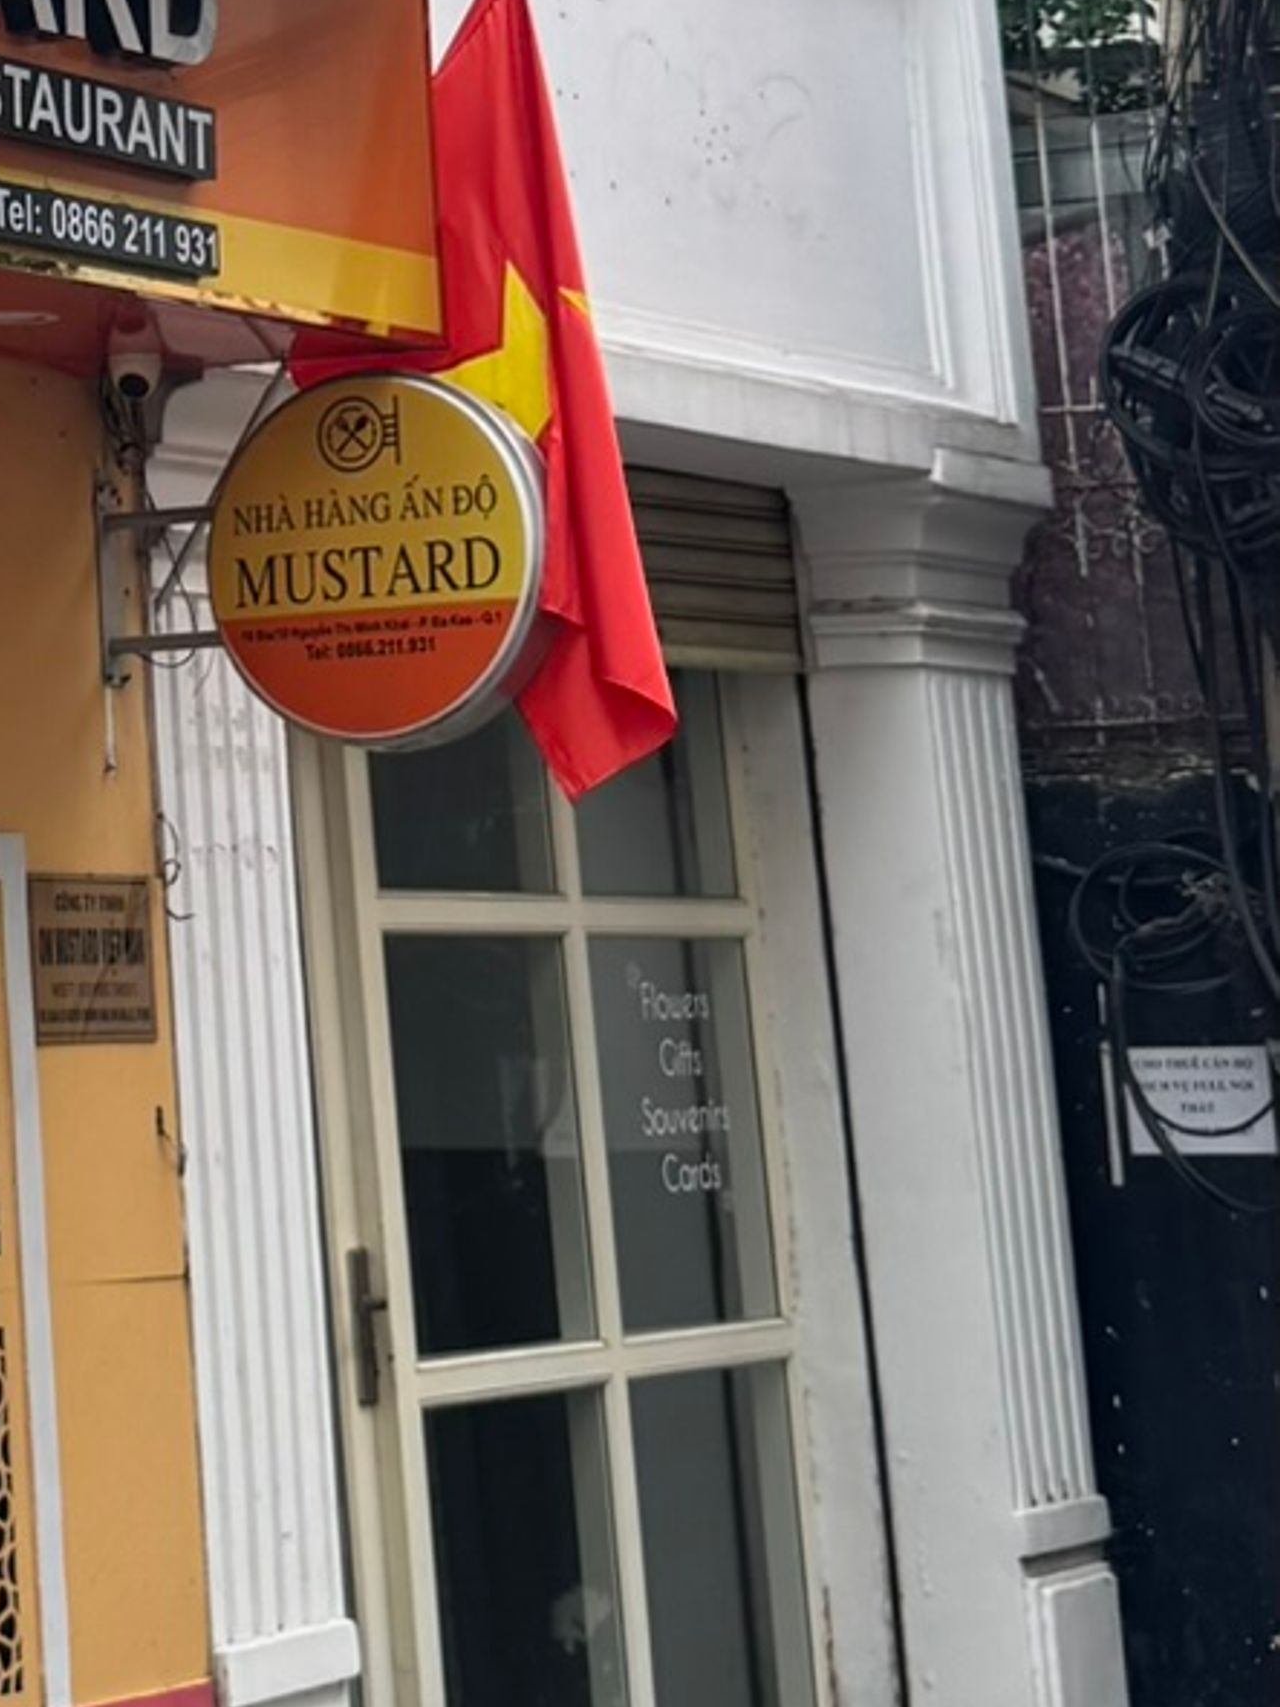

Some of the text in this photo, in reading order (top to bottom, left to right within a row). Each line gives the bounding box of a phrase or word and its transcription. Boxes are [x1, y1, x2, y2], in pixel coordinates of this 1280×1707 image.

[50, 197, 116, 250] 0866
[123, 213, 168, 259] 211
[174, 222, 219, 270] 931
[233, 473, 498, 537] NHÀ HÀNG ẤN ĐỘ
[234, 535, 502, 610] MUSTARD
[304, 643, 333, 662] Tel:
[639, 980, 710, 1021] Flowers
[658, 1037, 704, 1078] Gifts
[641, 1095, 731, 1136] Souvenirs
[661, 1152, 722, 1192] Cards
